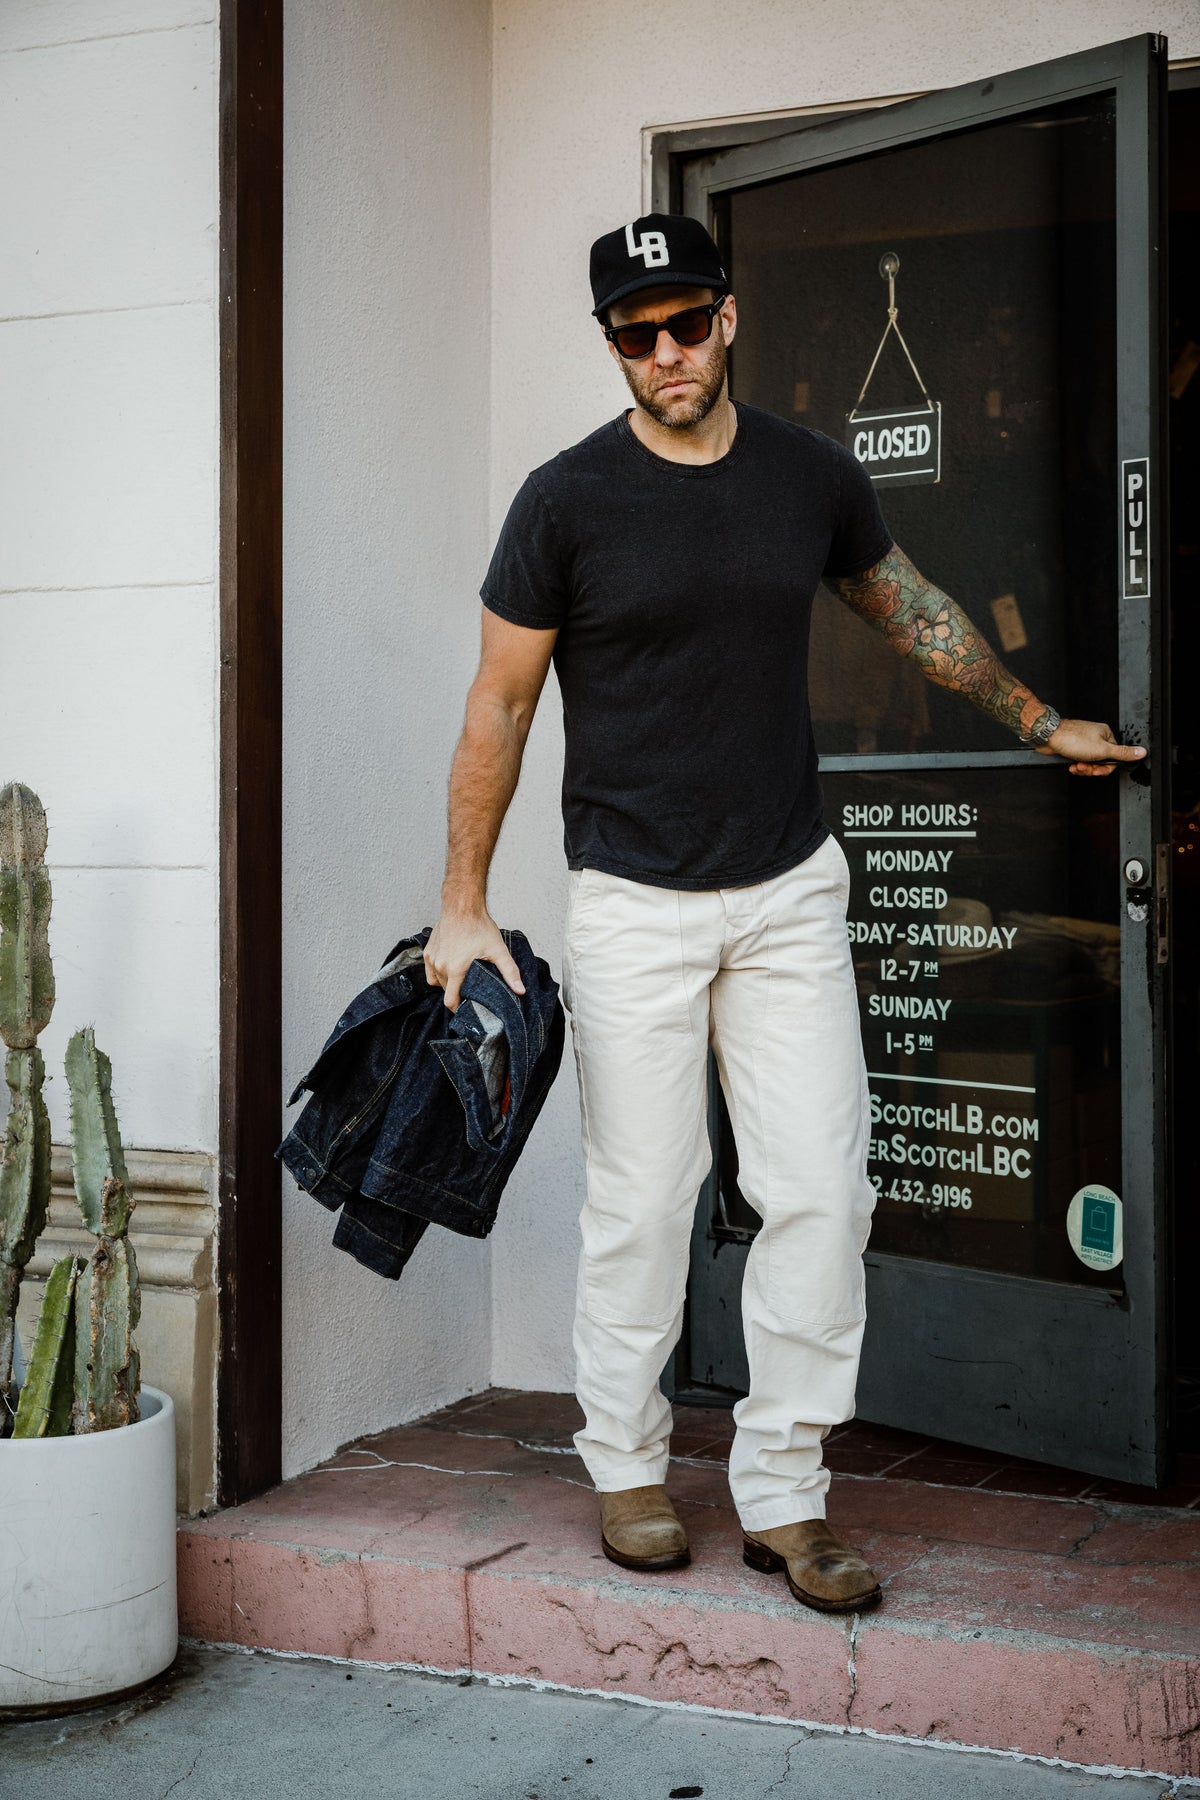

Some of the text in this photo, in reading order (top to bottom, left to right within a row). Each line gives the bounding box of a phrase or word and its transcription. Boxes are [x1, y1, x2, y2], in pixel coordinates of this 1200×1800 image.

[625, 223, 670, 268] LB
[854, 424, 931, 463] CLOSED
[1128, 473, 1143, 584] PULL
[842, 803, 978, 826] SHOP HOURS:
[866, 850, 953, 872] MONDAY
[869, 886, 948, 909] CLOSED
[880, 959, 939, 982] 12-7 PM
[868, 994, 952, 1021] SUNDAY
[886, 1032, 933, 1055] 1-5 PM
[867, 1174, 972, 1210] 2.432.9196
